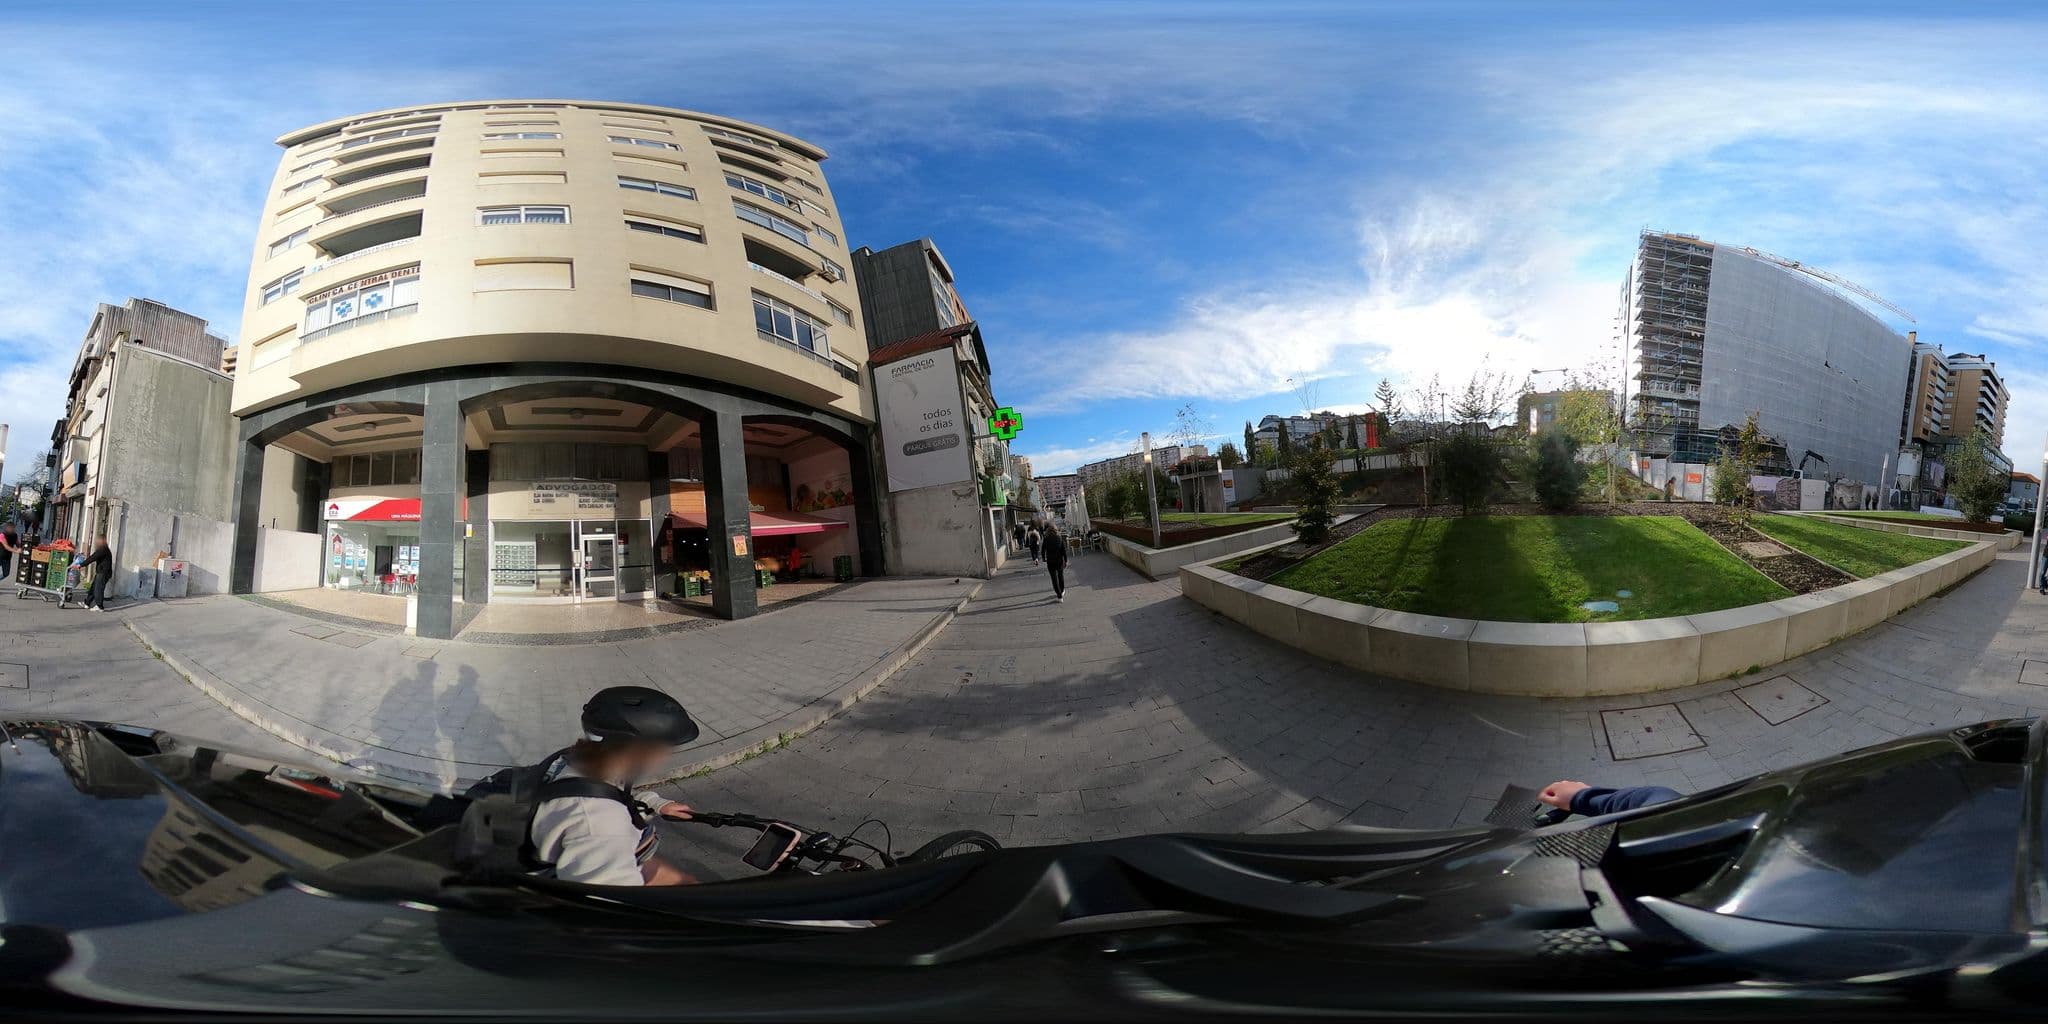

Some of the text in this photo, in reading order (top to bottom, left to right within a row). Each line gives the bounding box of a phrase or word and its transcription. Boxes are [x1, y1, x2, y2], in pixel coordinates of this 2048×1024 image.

[348, 274, 389, 291] CENTRAL
[923, 408, 952, 421] todos
[933, 420, 953, 430] dias
[536, 483, 613, 491] ADVOGADOS
